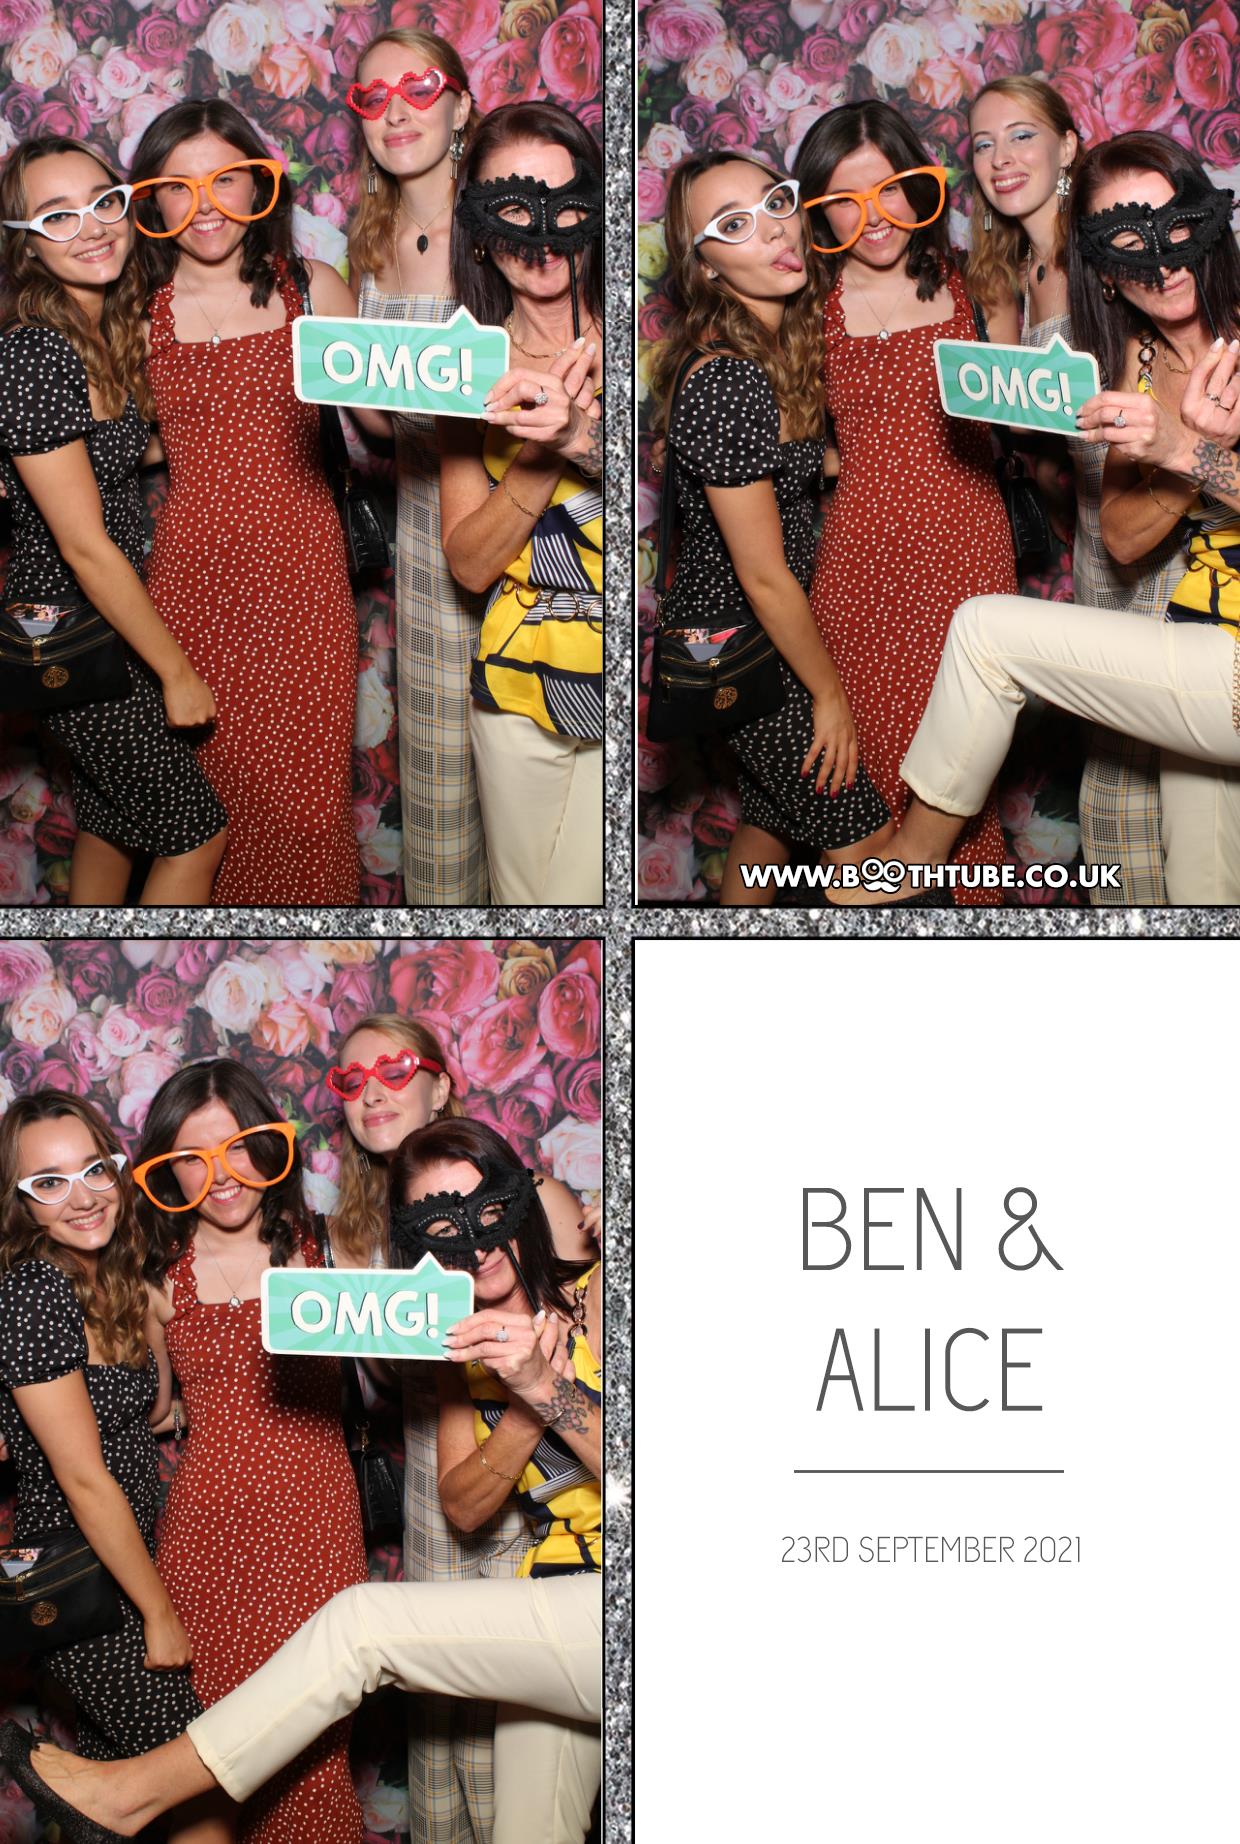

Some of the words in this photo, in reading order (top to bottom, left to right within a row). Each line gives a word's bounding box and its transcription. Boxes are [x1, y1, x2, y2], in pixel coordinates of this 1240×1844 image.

[322, 340, 473, 396] OMG!
[957, 362, 1073, 416] OMG!
[290, 1290, 440, 1339] OMG!
